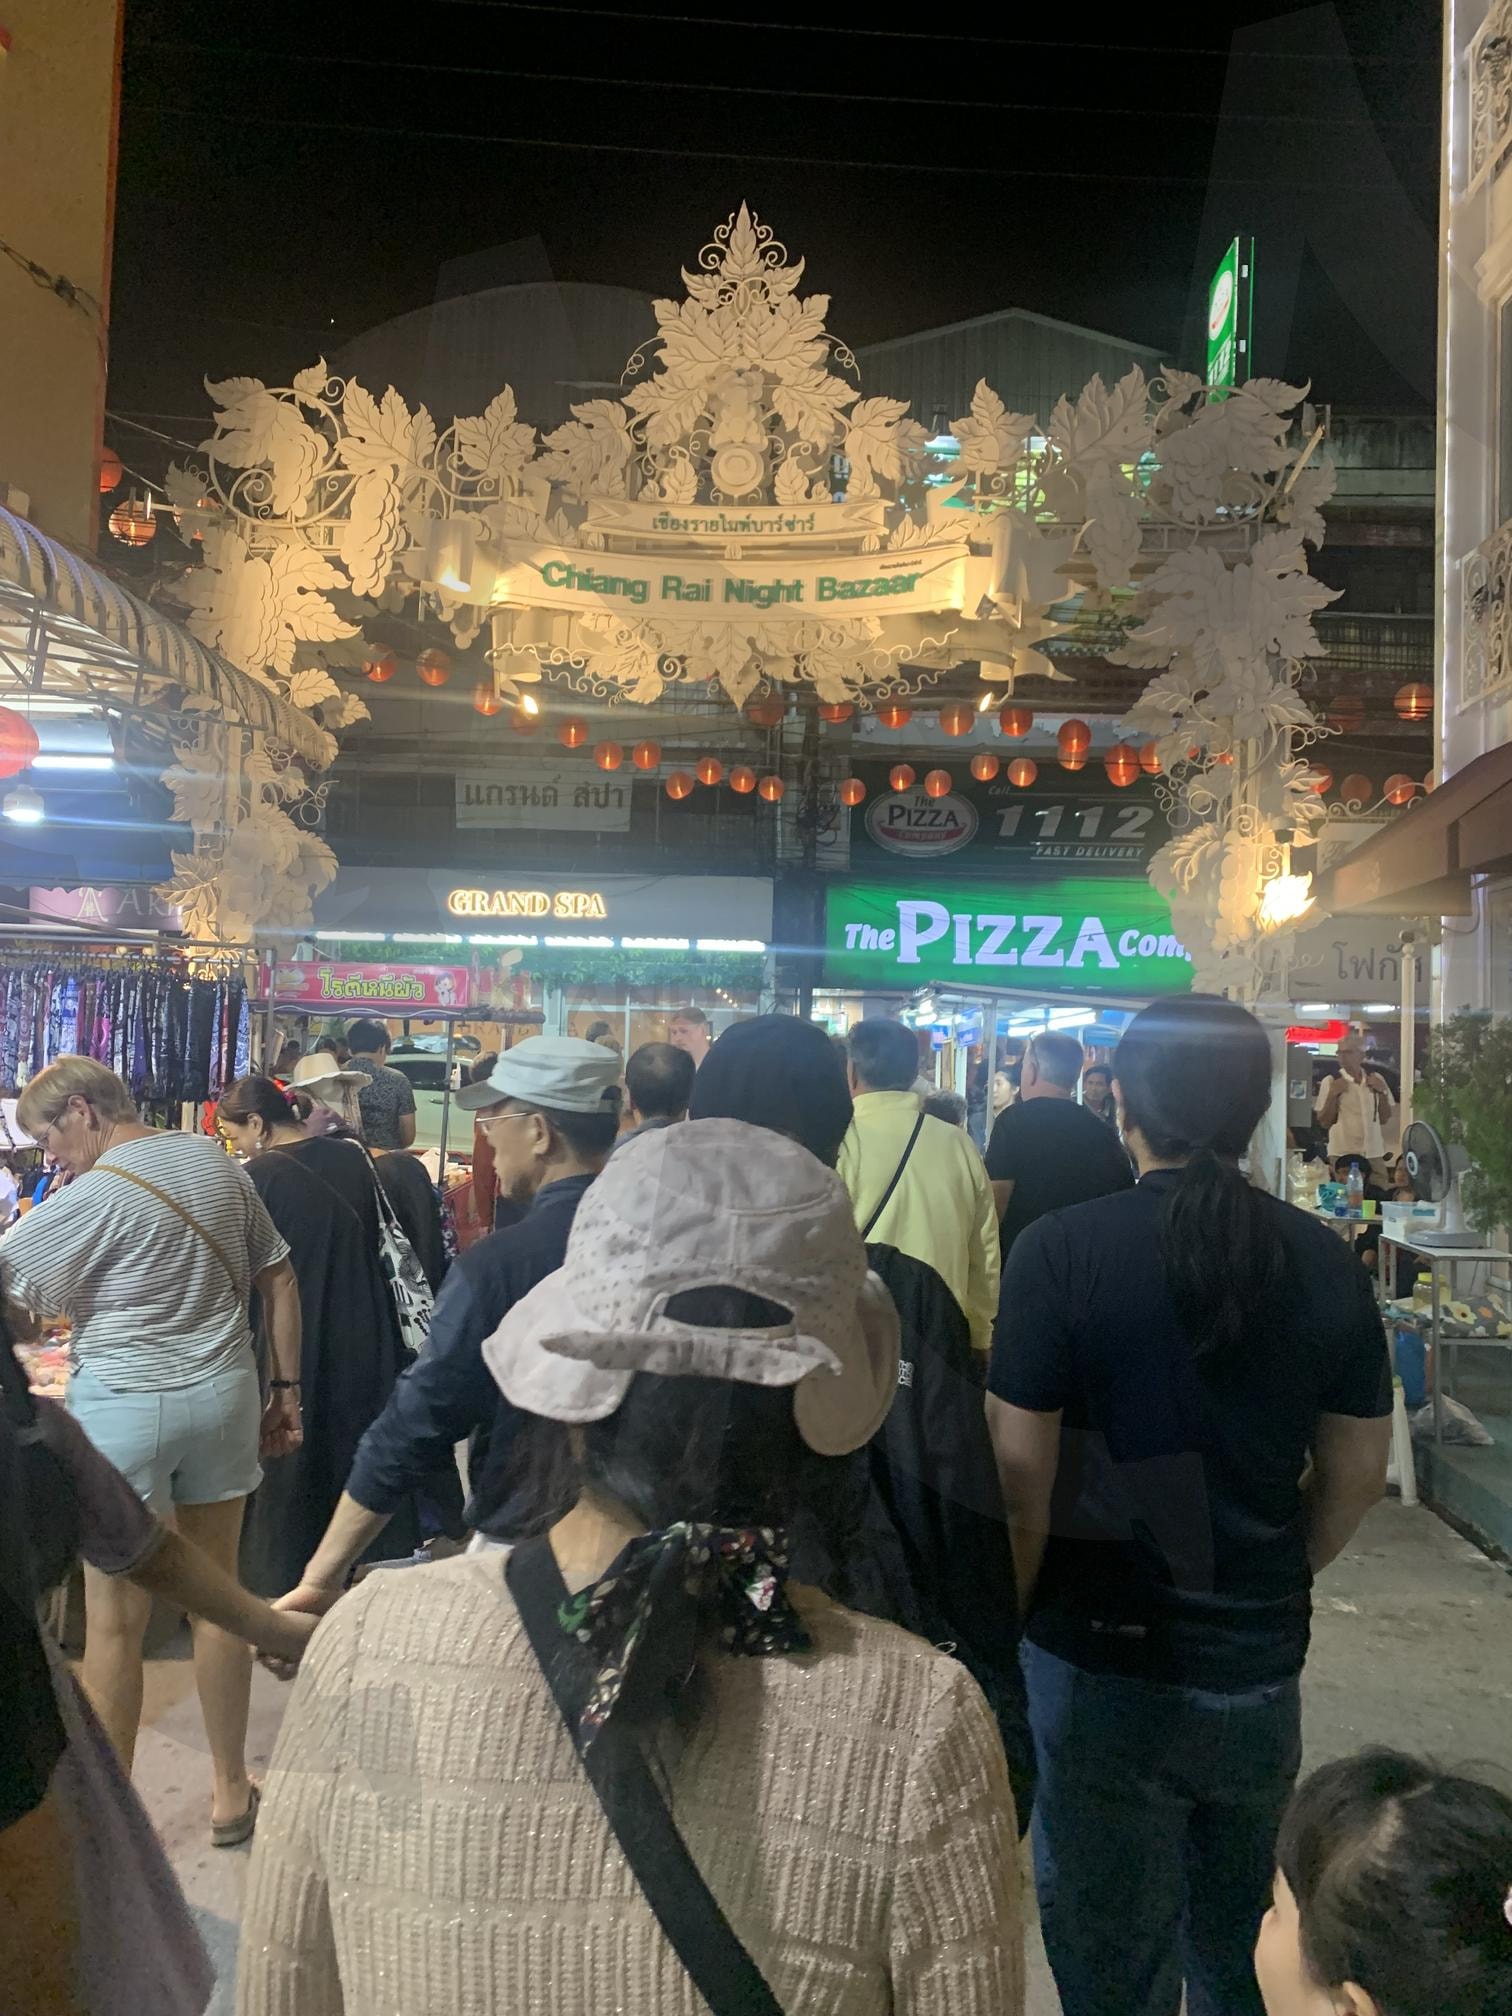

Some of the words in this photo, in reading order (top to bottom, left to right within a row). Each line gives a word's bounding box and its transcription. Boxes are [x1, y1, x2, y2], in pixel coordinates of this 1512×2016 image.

[542, 560, 650, 604] Chiang
[661, 575, 711, 602] Rai
[724, 578, 804, 609] Night
[815, 572, 921, 602] Bazaar
[465, 774, 561, 807] แกรนด์
[573, 781, 624, 809] สปา
[914, 795, 935, 807] The
[887, 804, 959, 827] PIZZA
[996, 805, 1154, 838] 1112
[1036, 846, 1069, 856] FAST
[1074, 847, 1145, 858] DELIVERY
[448, 889, 550, 916] GRAND
[553, 891, 608, 918] SPA
[845, 923, 896, 951] The
[896, 900, 1121, 968] PIZZA
[1118, 929, 1192, 962] Com
